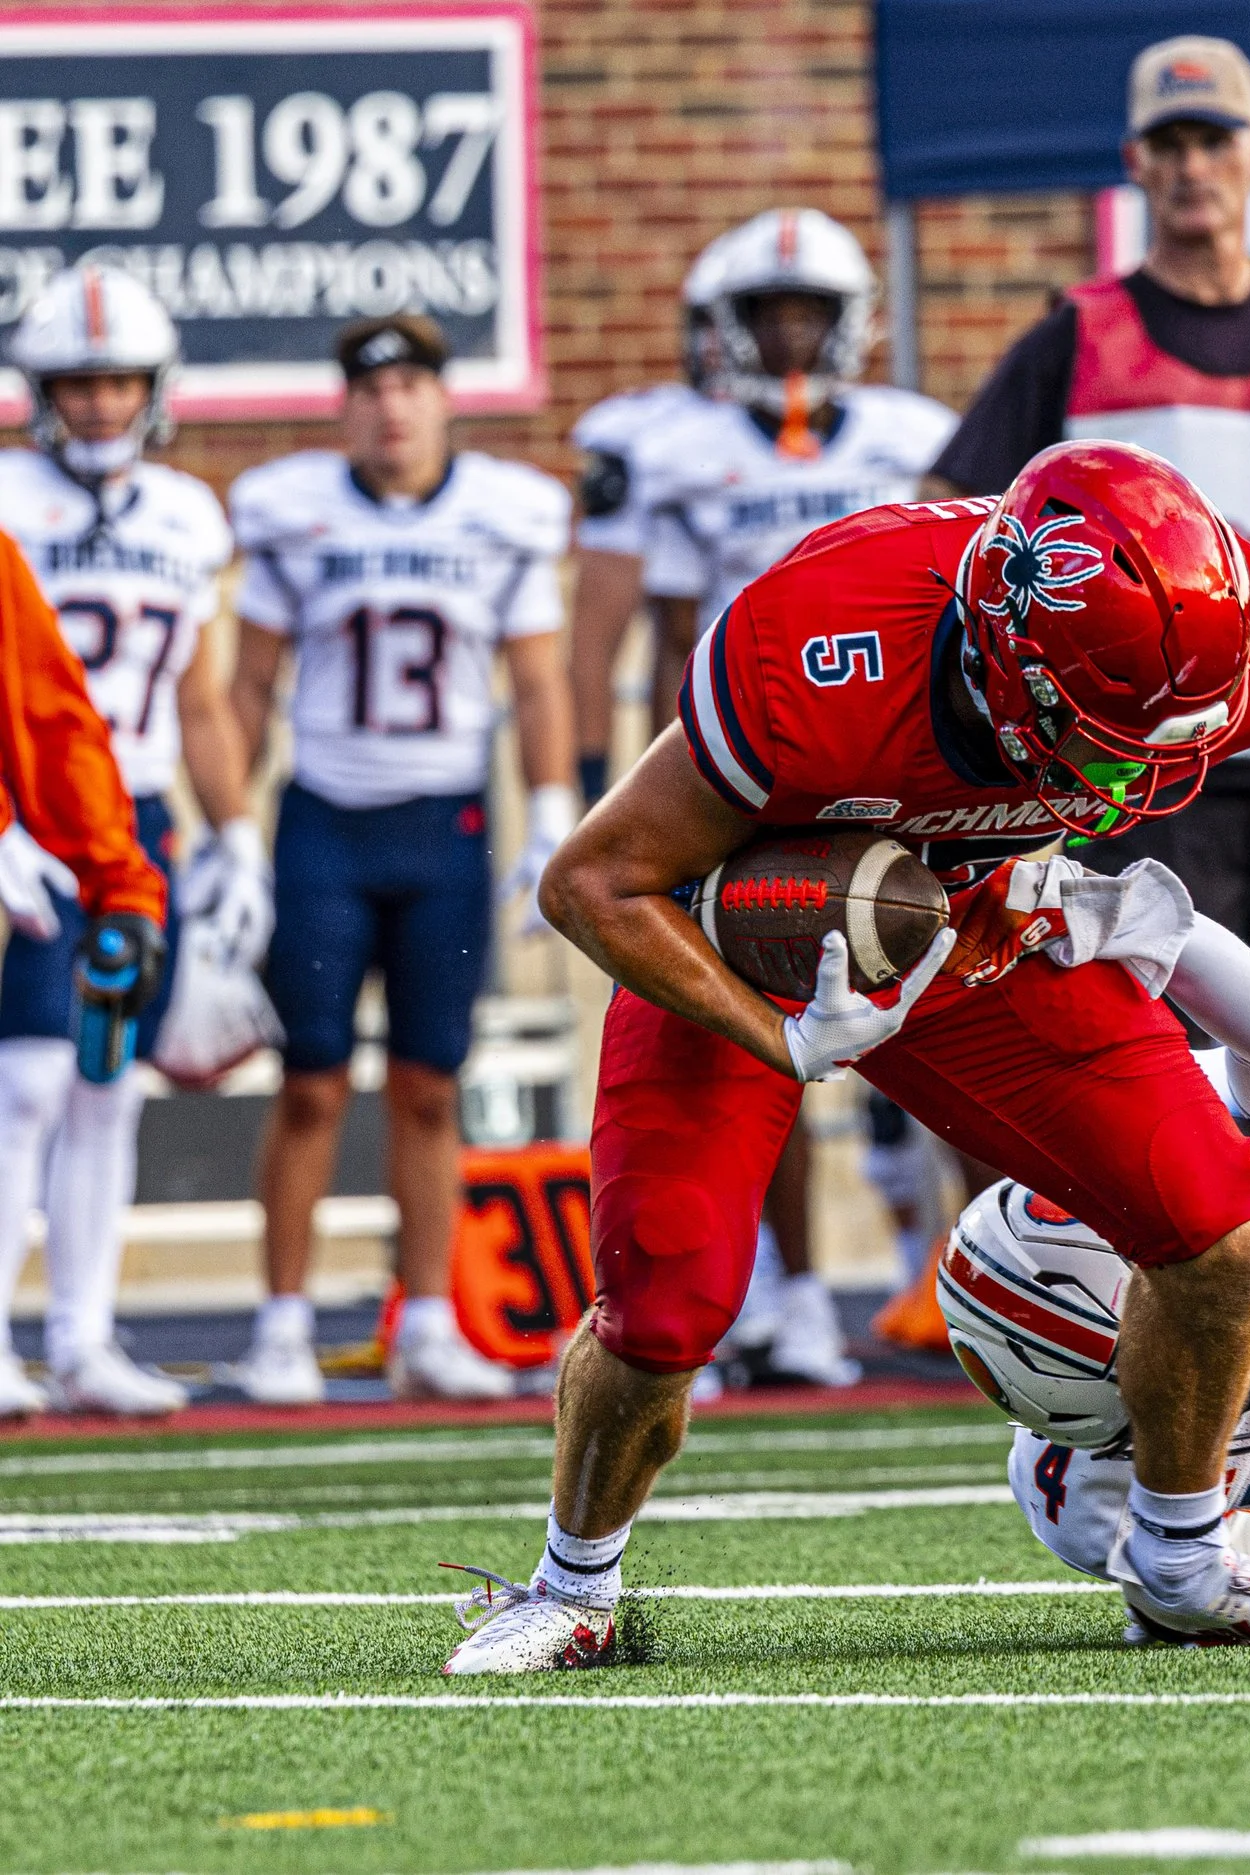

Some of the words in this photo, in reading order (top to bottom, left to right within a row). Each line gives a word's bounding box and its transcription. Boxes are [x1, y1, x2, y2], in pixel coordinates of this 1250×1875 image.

[197, 92, 500, 229] 1987
[341, 604, 451, 733] 13
[801, 630, 884, 687] 5
[893, 795, 1142, 834] ICHMON
[1034, 1442, 1074, 1526] 4
